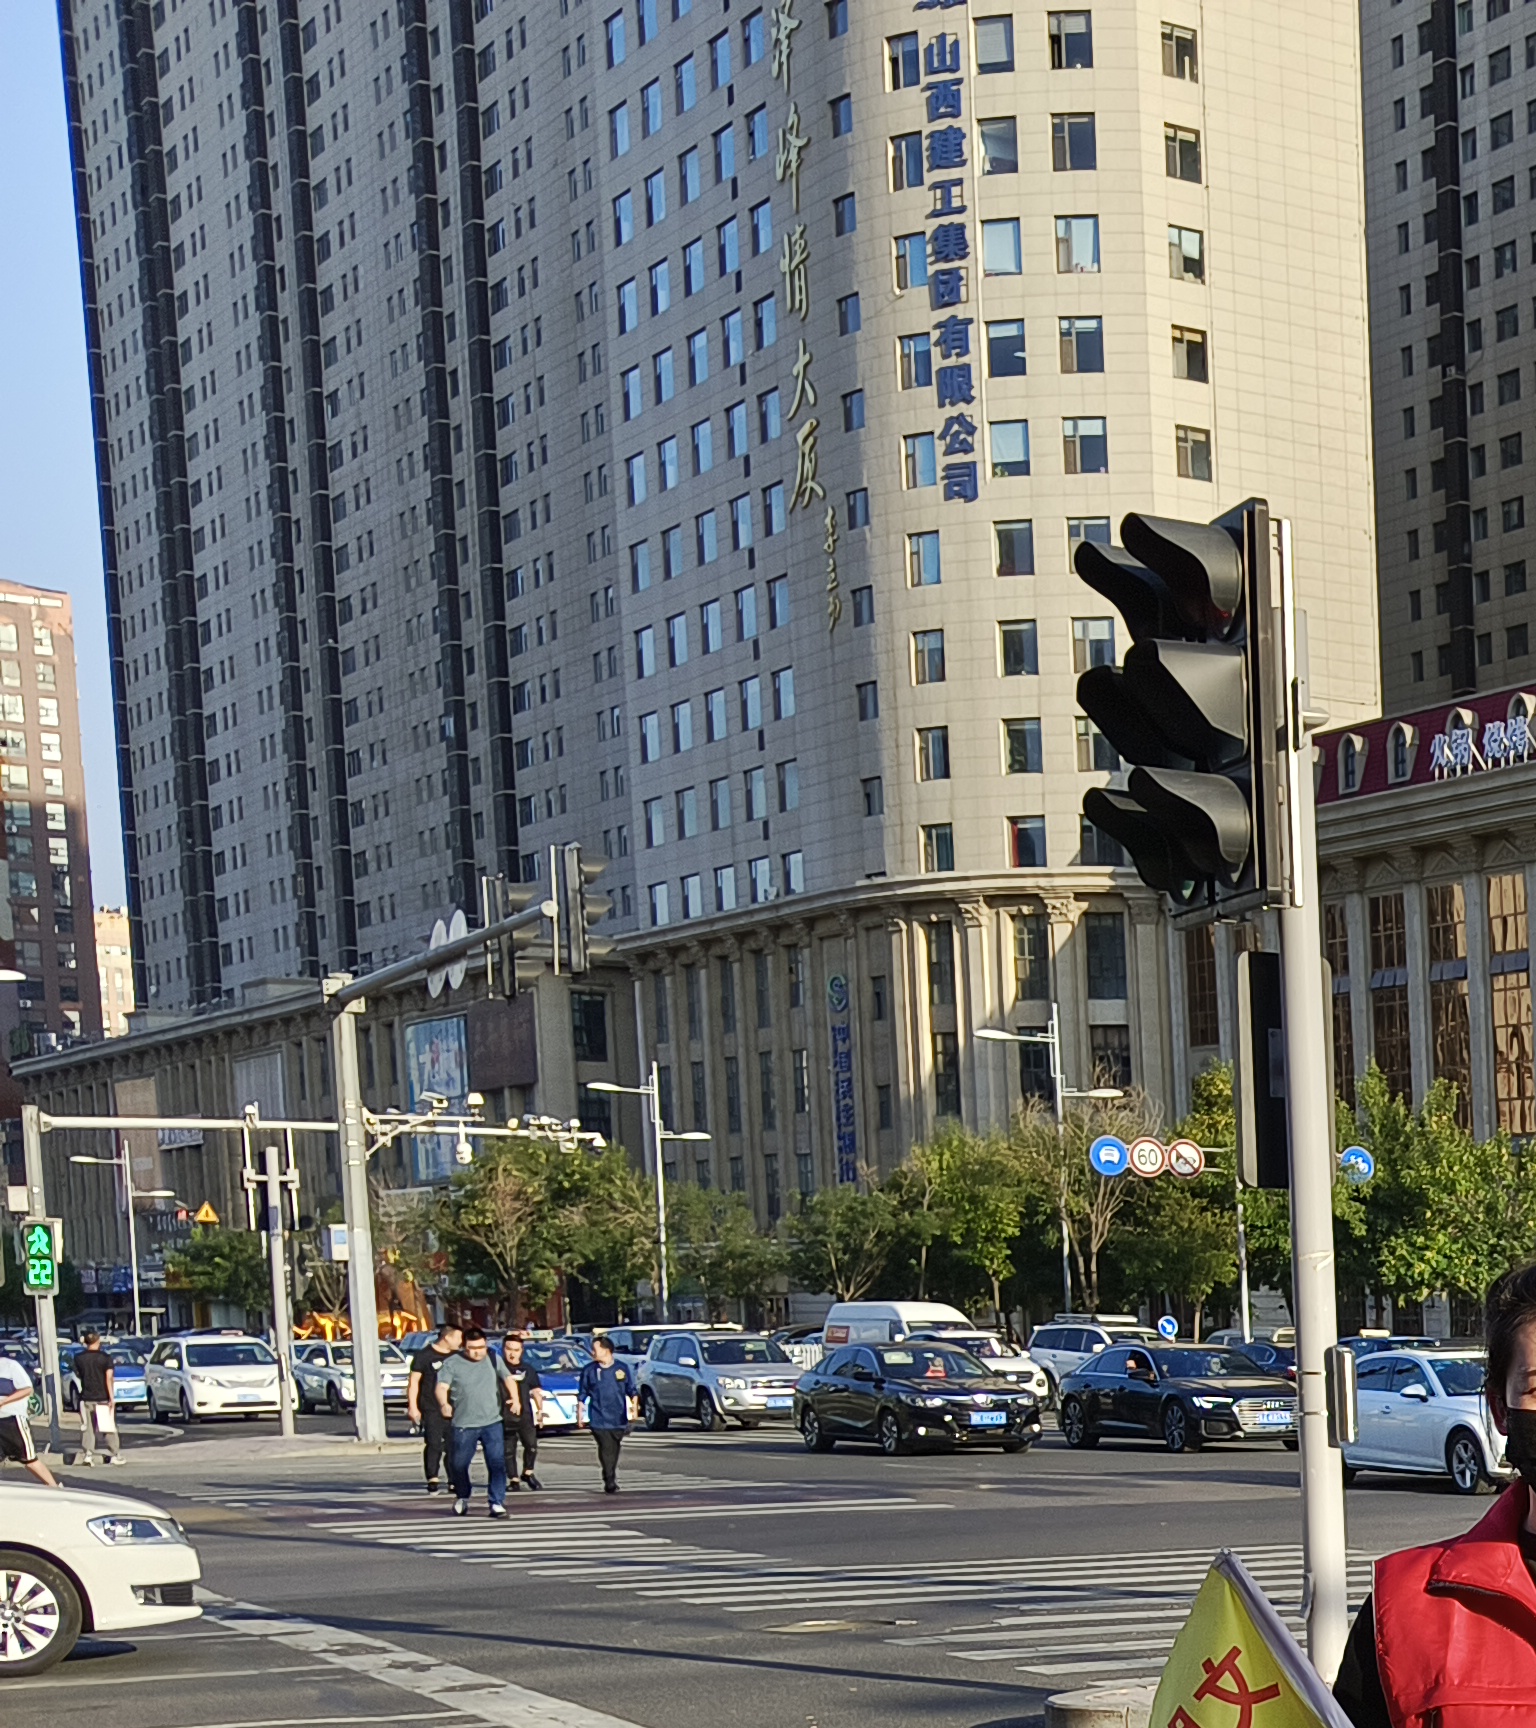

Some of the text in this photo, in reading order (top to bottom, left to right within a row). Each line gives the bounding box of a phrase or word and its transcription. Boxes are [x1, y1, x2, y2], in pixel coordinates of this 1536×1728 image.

[921, 32, 978, 503] 山西建工集团有限公司
[1430, 728, 1473, 770] 火锅
[1138, 1148, 1158, 1166] 60
[28, 1259, 52, 1285] 22
